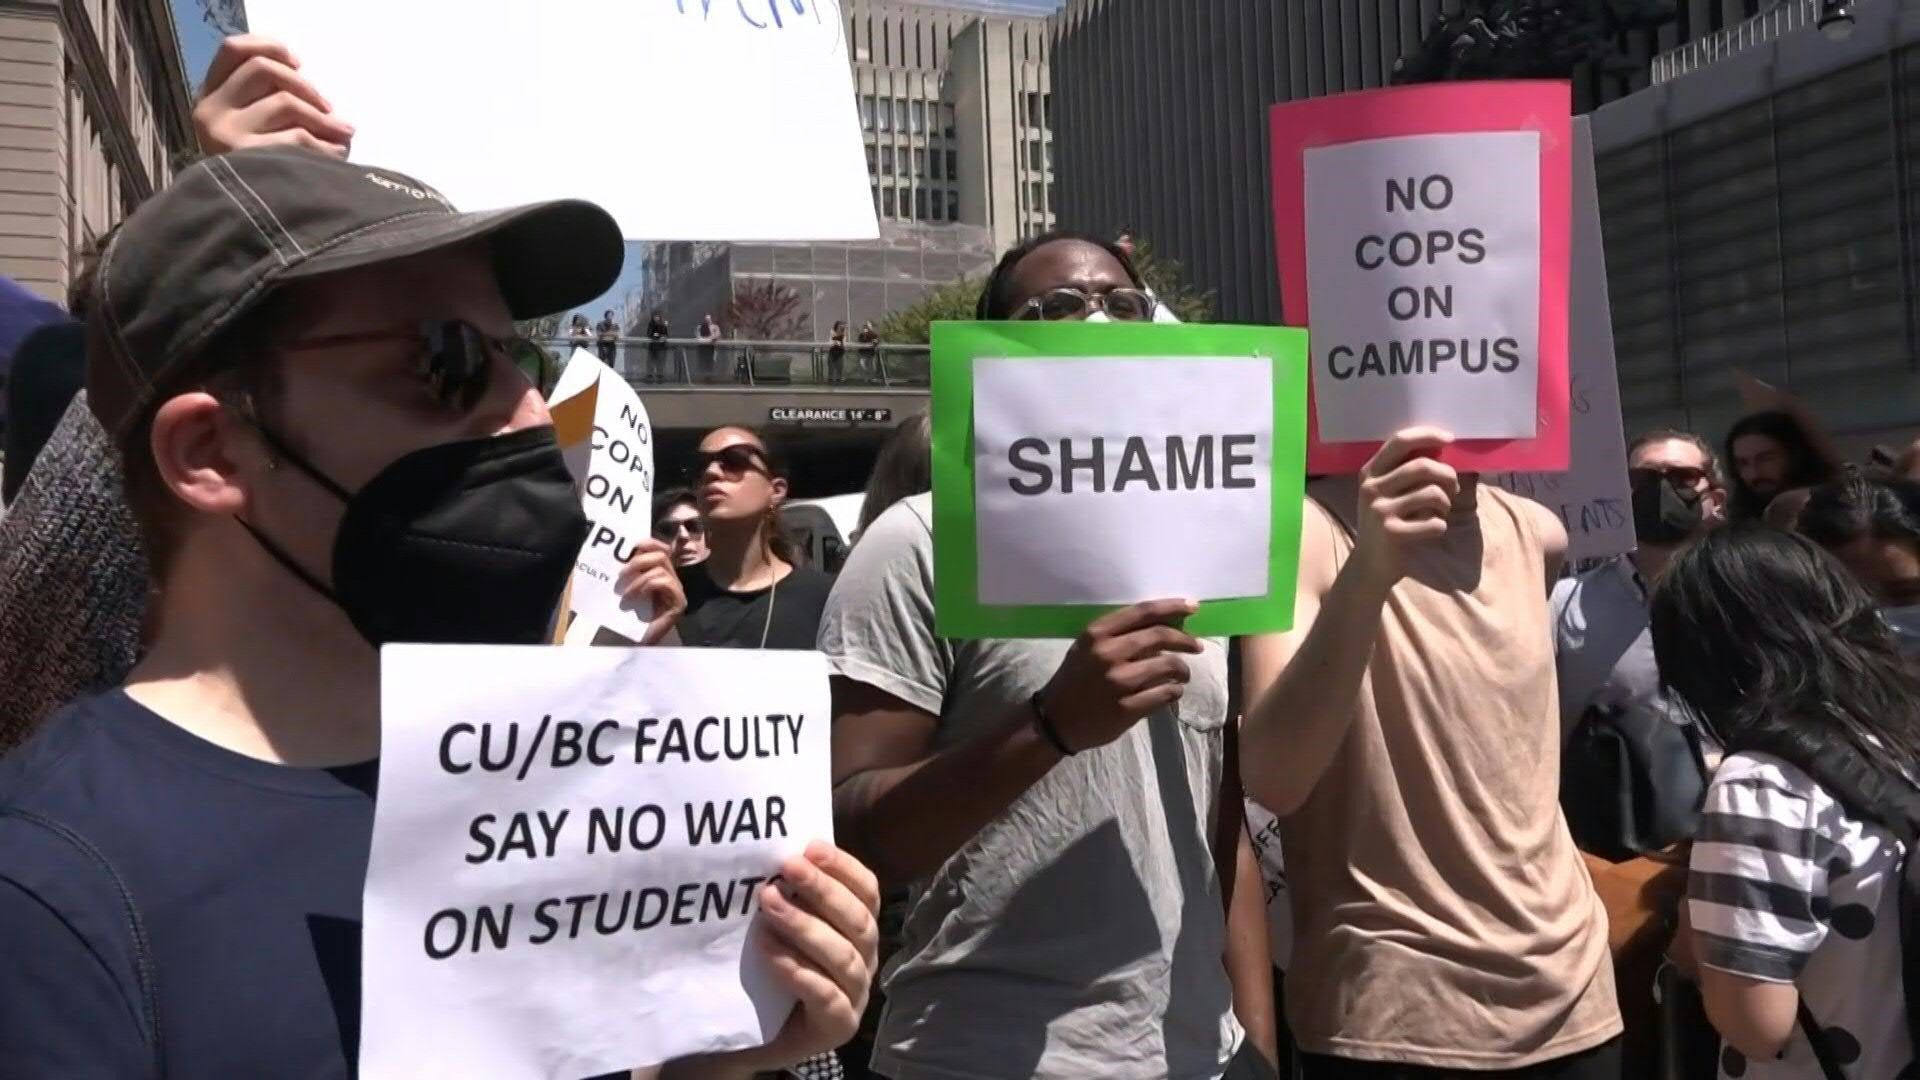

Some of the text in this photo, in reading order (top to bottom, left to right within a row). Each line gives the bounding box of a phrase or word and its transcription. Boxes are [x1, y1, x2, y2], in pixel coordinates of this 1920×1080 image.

[1386, 174, 1454, 213] NO
[1355, 228, 1487, 271] COPS
[1387, 285, 1453, 321] ON
[1327, 337, 1521, 381] CAMPUS
[620, 404, 648, 445] NO
[772, 408, 846, 421] CLEARANCE
[1008, 434, 1256, 496] SHAME
[586, 474, 634, 514] ON
[439, 713, 804, 781] CU/BC FACULTY
[465, 796, 788, 865] SAY NO WAR
[424, 904, 514, 960] ON
